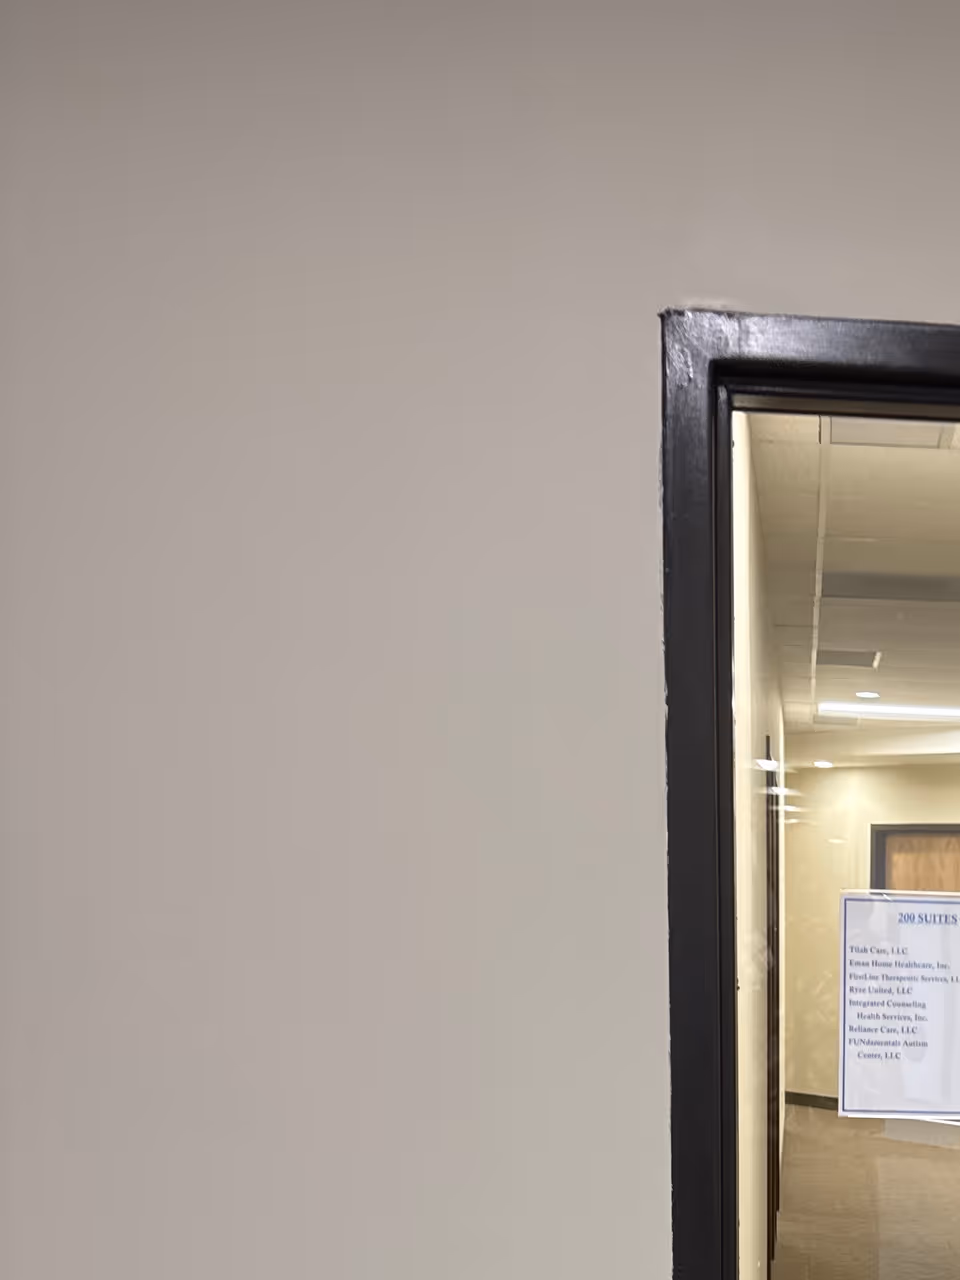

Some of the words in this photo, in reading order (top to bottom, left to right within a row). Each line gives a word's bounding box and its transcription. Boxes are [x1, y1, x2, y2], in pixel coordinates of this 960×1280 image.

[898, 912, 916, 925] 200
[918, 913, 958, 926] SUITES
[849, 945, 868, 954] Tilah
[870, 946, 889, 956] Care,
[891, 946, 908, 955] LLC
[871, 959, 892, 968] Home
[894, 960, 935, 970] Healthcare,
[936, 961, 950, 970] Inc.
[881, 973, 919, 984] Therapeutic
[920, 975, 949, 984] Services,
[868, 986, 894, 996] United,
[896, 986, 913, 995] LLC
[849, 1000, 885, 1009] Integrated
[886, 1000, 926, 1009] Counseling
[857, 1012, 880, 1021] Health
[882, 1013, 912, 1022] Services,
[914, 1014, 928, 1022] Inc.
[848, 1025, 878, 1034] Reliance
[880, 1026, 900, 1035] Care,
[901, 1026, 918, 1034] LLC
[848, 1038, 901, 1047] FUNdamentals
[902, 1039, 928, 1048] Autism
[857, 1051, 883, 1061] Center,
[884, 1052, 902, 1060] LLC
